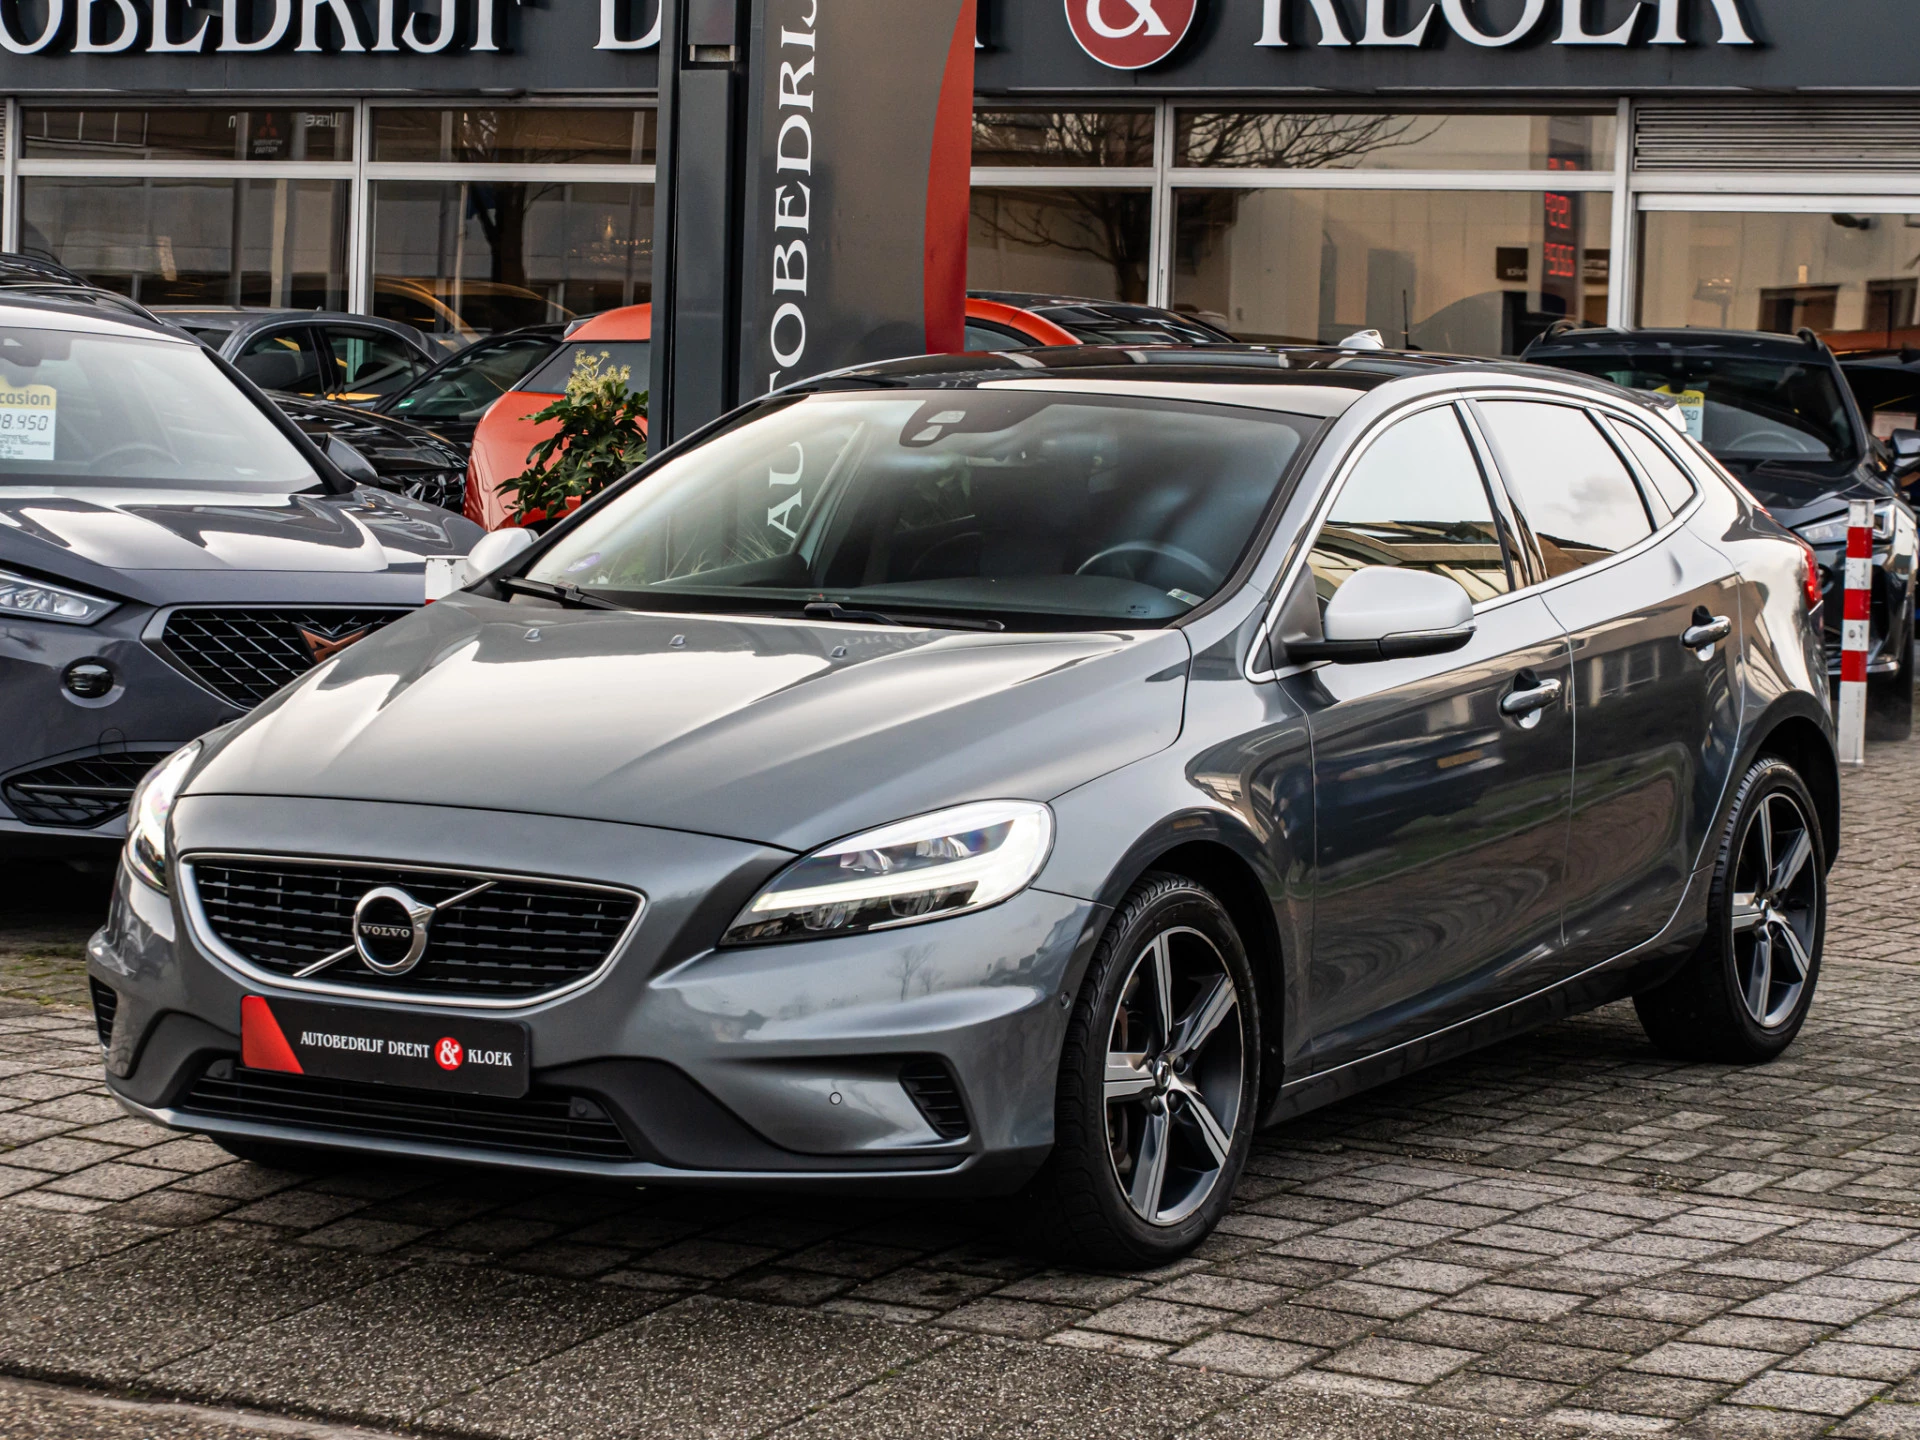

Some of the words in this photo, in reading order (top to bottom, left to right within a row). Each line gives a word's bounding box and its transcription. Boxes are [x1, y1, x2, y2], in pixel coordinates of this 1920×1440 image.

[360, 925, 410, 938] VOLVO
[300, 1031, 384, 1053] AUTOBEDRIJF
[388, 1040, 430, 1058] DRENT
[440, 1039, 459, 1066] &
[467, 1048, 513, 1067] KLOEK
